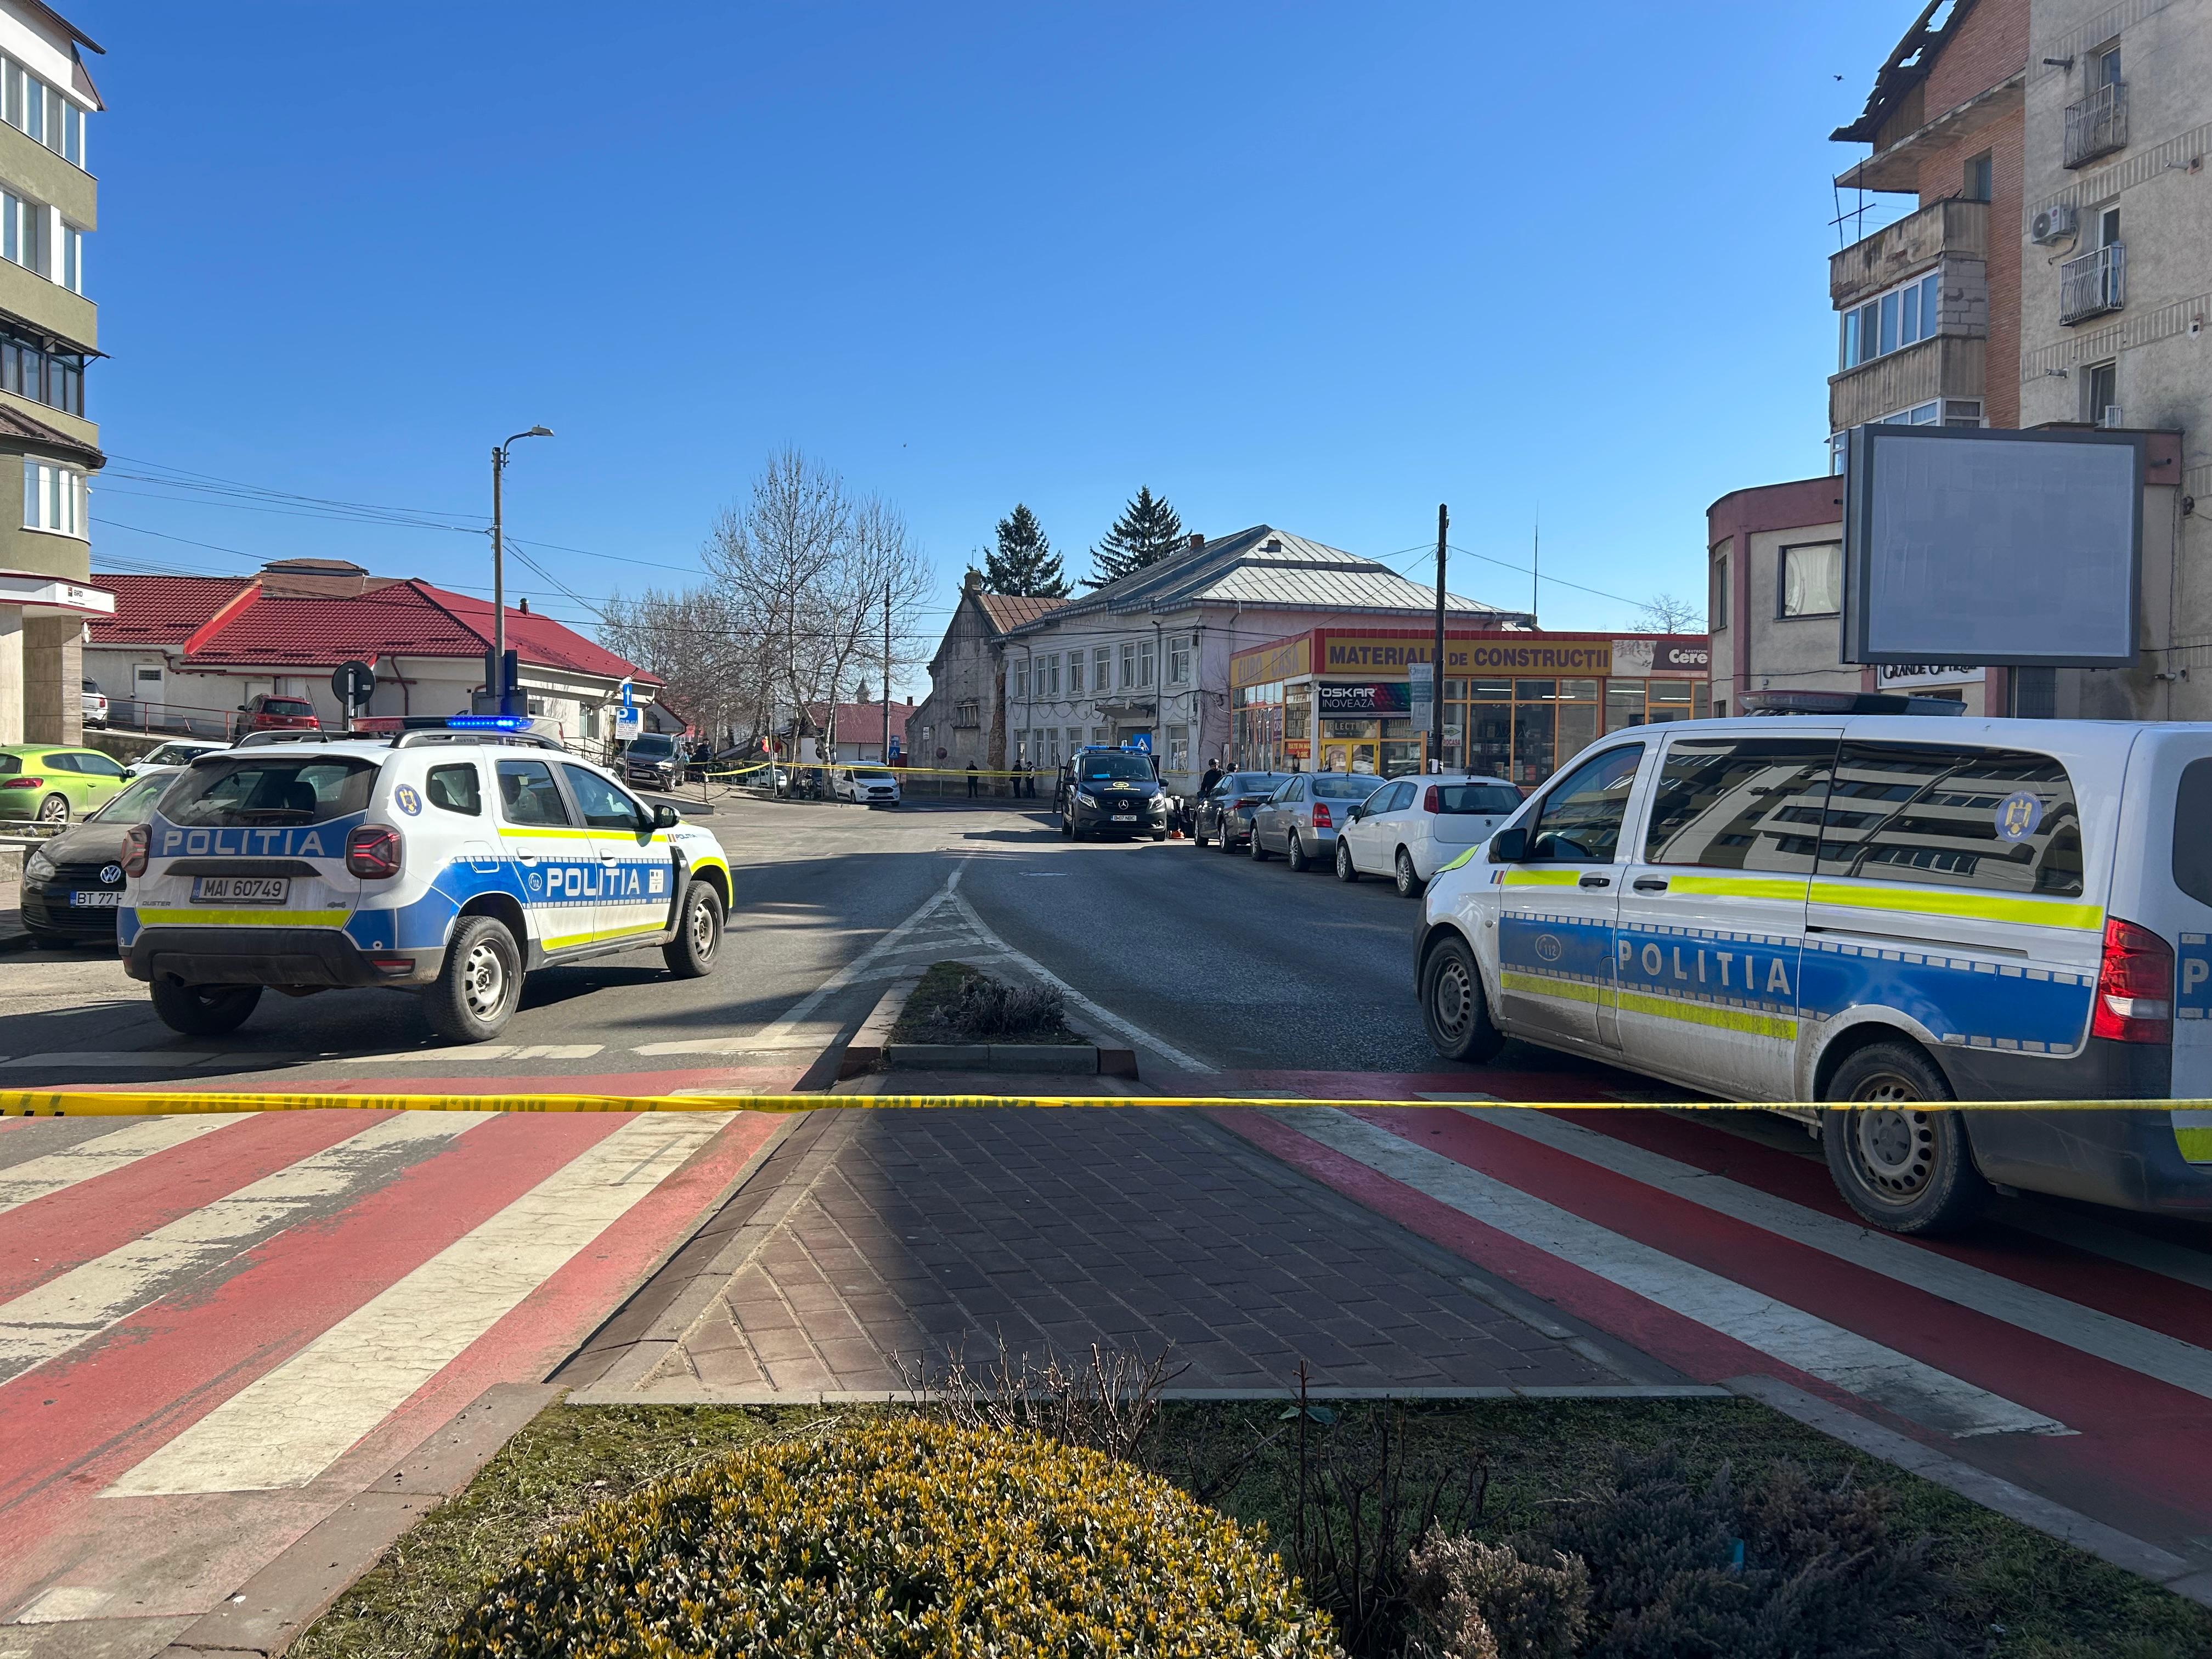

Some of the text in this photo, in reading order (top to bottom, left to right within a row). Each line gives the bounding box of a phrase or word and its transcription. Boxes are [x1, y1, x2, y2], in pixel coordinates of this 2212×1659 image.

[1449, 653, 1468, 666] DE
[1669, 649, 1708, 664] Cere
[1322, 688, 1375, 697] OSKAR
[163, 830, 325, 856] POLITIA
[204, 881, 282, 898] MAI 60749
[546, 868, 640, 897] POLITIA
[77, 893, 94, 904] BT
[99, 893, 114, 904] 77
[1543, 944, 1557, 957] 112
[1618, 939, 1791, 995] POLITIA
[2182, 958, 2209, 994] P
